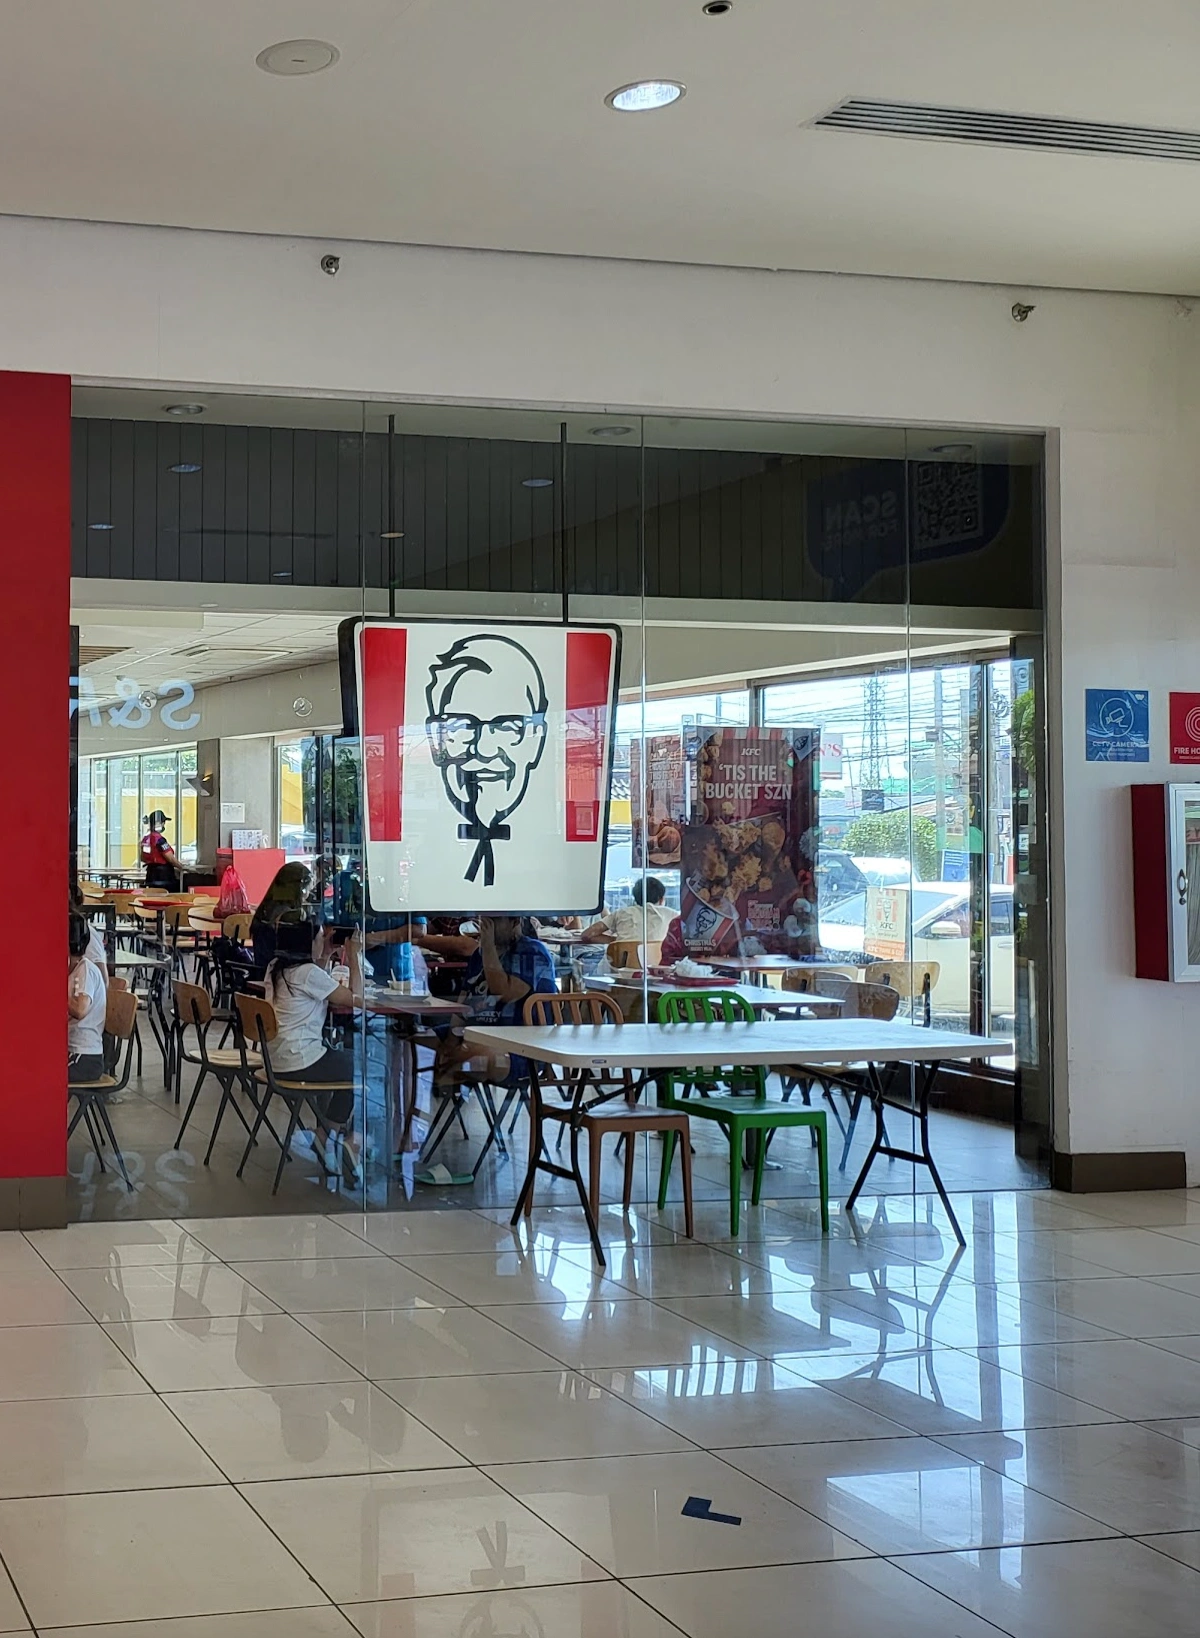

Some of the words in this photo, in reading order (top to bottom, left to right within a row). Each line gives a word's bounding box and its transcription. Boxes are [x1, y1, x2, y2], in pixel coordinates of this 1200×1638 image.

[741, 747, 761, 756] KFC
[1173, 747, 1190, 755] FIRE
[748, 764, 777, 781] THE
[705, 783, 762, 800] BUCKET
[764, 783, 793, 800] SZN
[684, 939, 717, 947] CHRISTMAS
